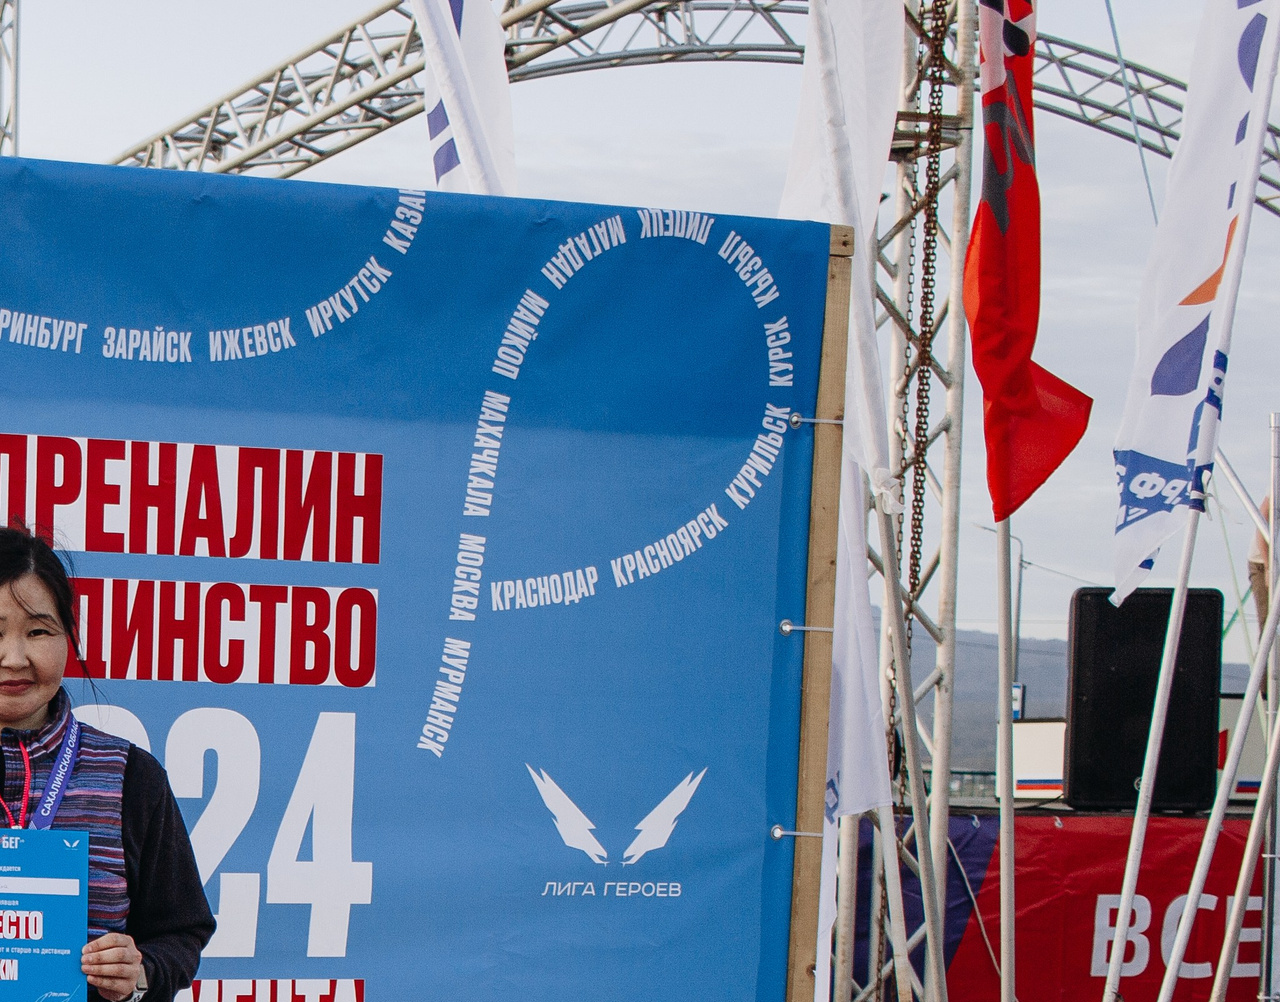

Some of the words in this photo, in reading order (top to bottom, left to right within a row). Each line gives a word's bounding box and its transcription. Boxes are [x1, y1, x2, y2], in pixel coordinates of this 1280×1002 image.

[541, 215, 626, 290] МАГАДАН
[637, 208, 716, 246] ЛИПЕЦК
[718, 231, 780, 308] КЫЗЫЛ
[102, 327, 192, 362] ЗАРАЙСК
[209, 317, 297, 362] ИЖЕВСК
[306, 255, 392, 338] ИРКУТСК
[492, 288, 550, 380] МАЙКОП
[763, 316, 793, 387] КУРСК
[463, 390, 511, 517] МАХАЧКАЛА
[724, 403, 791, 510] КУРИЛЬСК
[449, 533, 486, 621] МОСКВА
[610, 503, 729, 588] КРАСНОЯРСК
[491, 566, 598, 611] КРАСНОДАР
[417, 637, 471, 758] МУРМАНСК
[41, 748, 73, 816] САХАЛИНСКАЯ
[541, 882, 595, 896] ЛИГА
[604, 882, 682, 897] ГЕРОЕВ
[41, 948, 71, 956] дистанции
